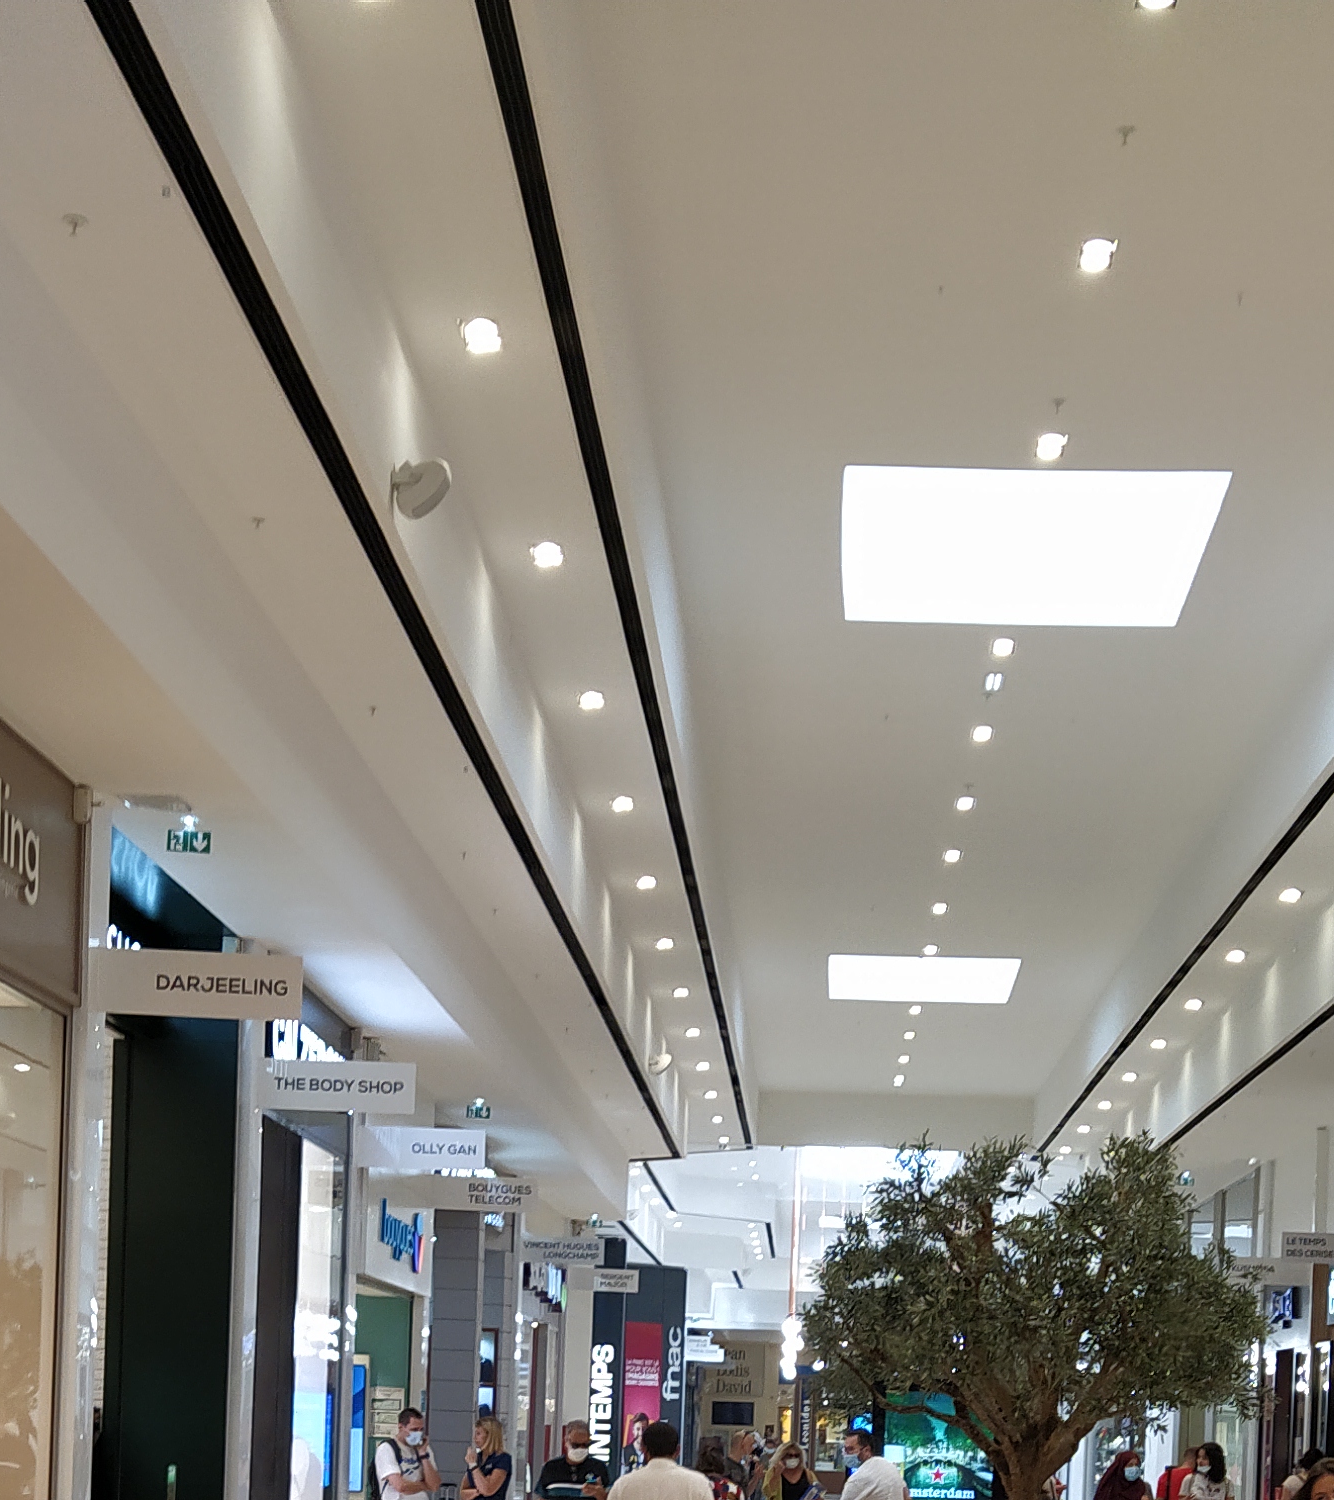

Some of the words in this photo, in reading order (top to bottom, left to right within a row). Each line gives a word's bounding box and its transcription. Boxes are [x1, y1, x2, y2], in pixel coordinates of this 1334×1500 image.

[155, 973, 289, 997] DARJEELING
[274, 1076, 306, 1092] THE
[309, 1078, 355, 1093] BODY
[357, 1079, 405, 1095] SHOP
[411, 1141, 446, 1155] OLLY
[447, 1141, 478, 1156] GAN
[468, 1182, 533, 1196] BOUYGUES
[468, 1194, 522, 1207] TELECOM
[1285, 1236, 1297, 1246] LE
[1298, 1237, 1327, 1247] TEMPS
[662, 1325, 682, 1402] fnac
[715, 1378, 752, 1394] David
[588, 1343, 615, 1465] INTEMPS
[909, 1486, 975, 1500] msterdam
